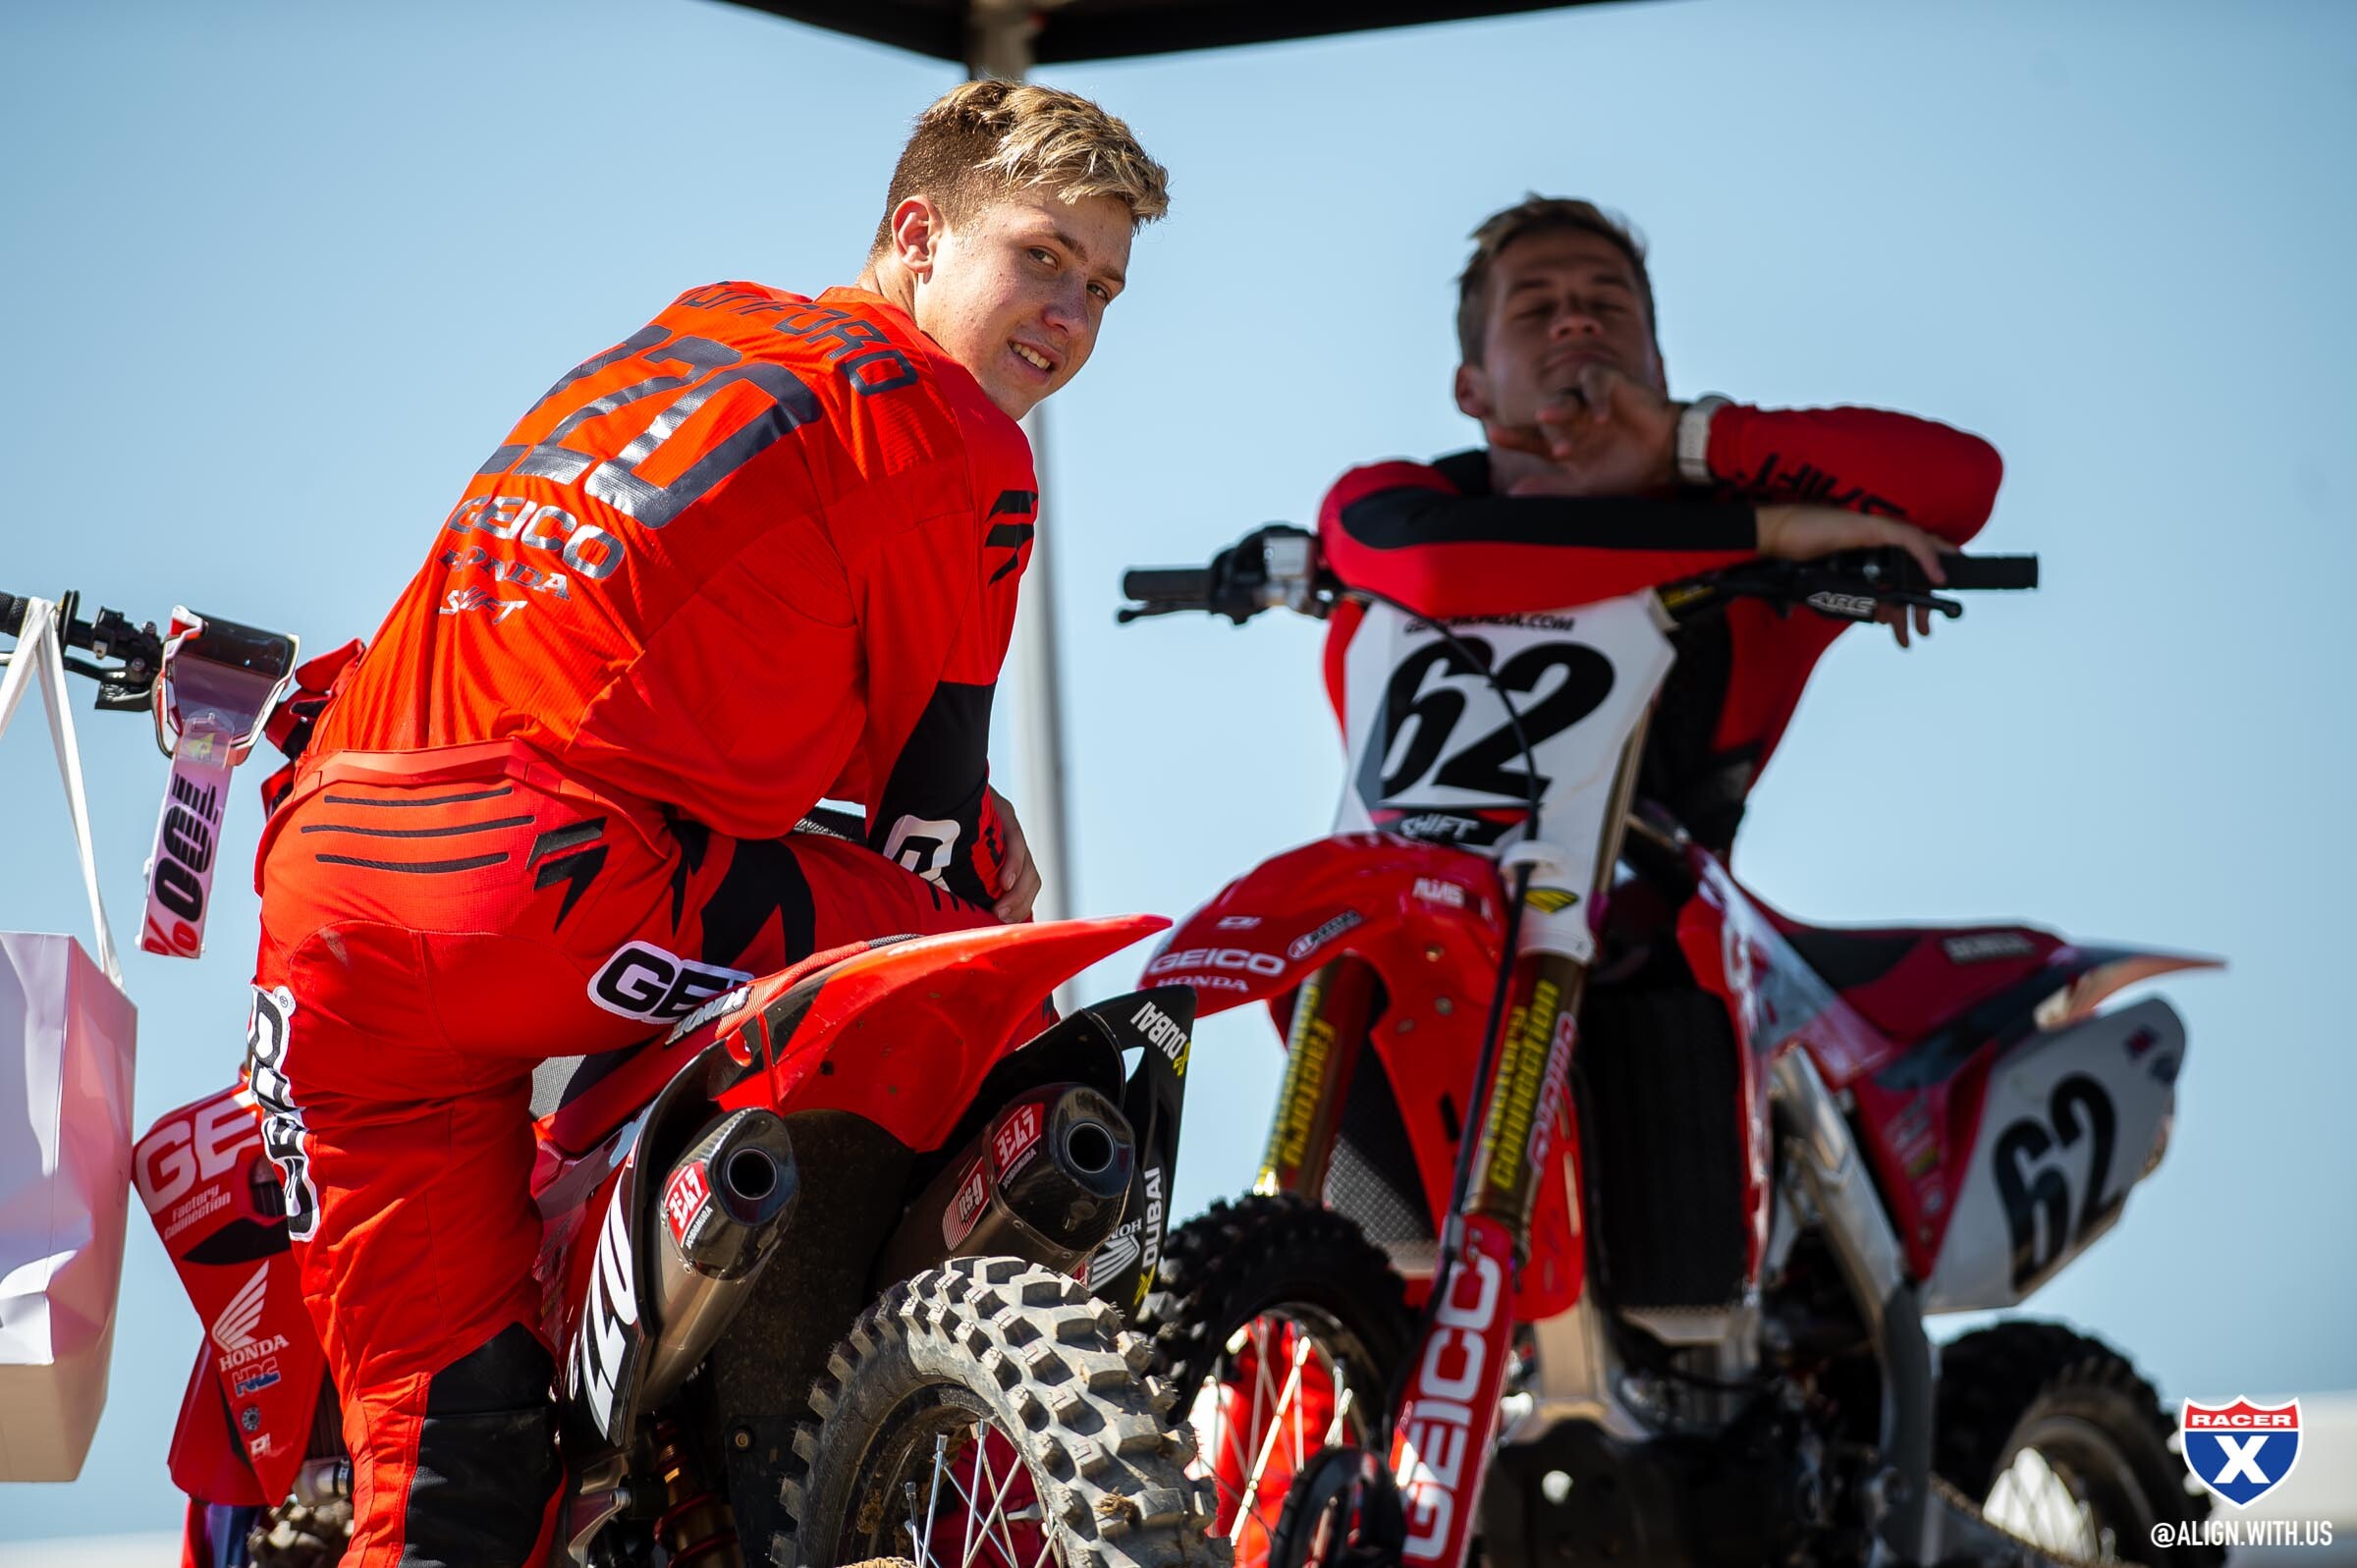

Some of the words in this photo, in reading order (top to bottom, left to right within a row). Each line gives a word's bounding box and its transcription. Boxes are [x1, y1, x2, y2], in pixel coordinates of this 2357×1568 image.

[448, 494, 625, 579] GEICO
[1380, 633, 1616, 801] 62
[1400, 814, 1480, 840] SHIFT
[1147, 948, 1287, 977] GEICO
[219, 1333, 290, 1373] HONDA
